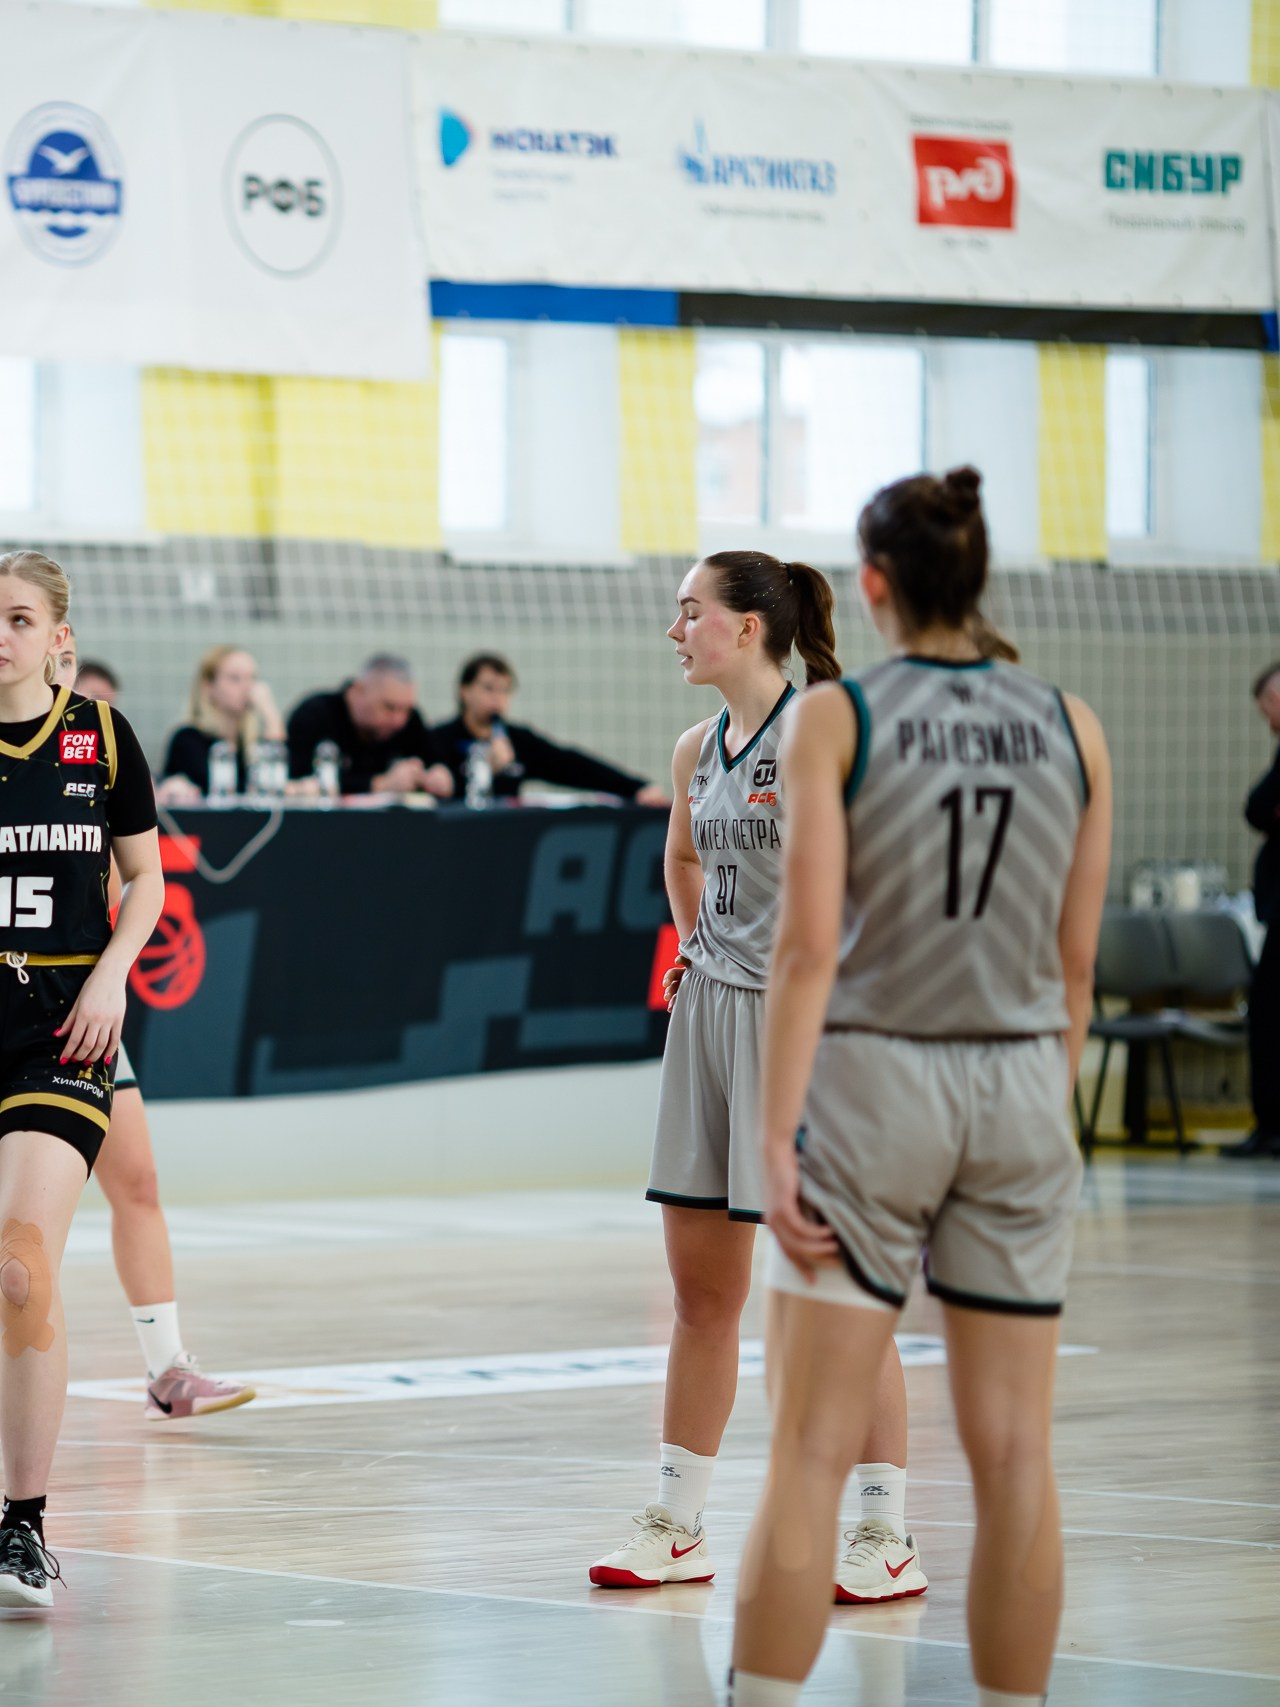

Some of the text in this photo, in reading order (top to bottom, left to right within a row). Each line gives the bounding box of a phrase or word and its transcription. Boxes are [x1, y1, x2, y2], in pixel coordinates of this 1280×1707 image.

[1105, 151, 1243, 194] СИБУР
[243, 173, 326, 217] РФБ
[62, 733, 96, 747] FON
[63, 746, 95, 760] BET
[732, 818, 782, 850] ПЕТРА
[939, 784, 1014, 923] 17
[715, 865, 738, 916] 97
[52, 1075, 104, 1099] ХИМПРОМ
